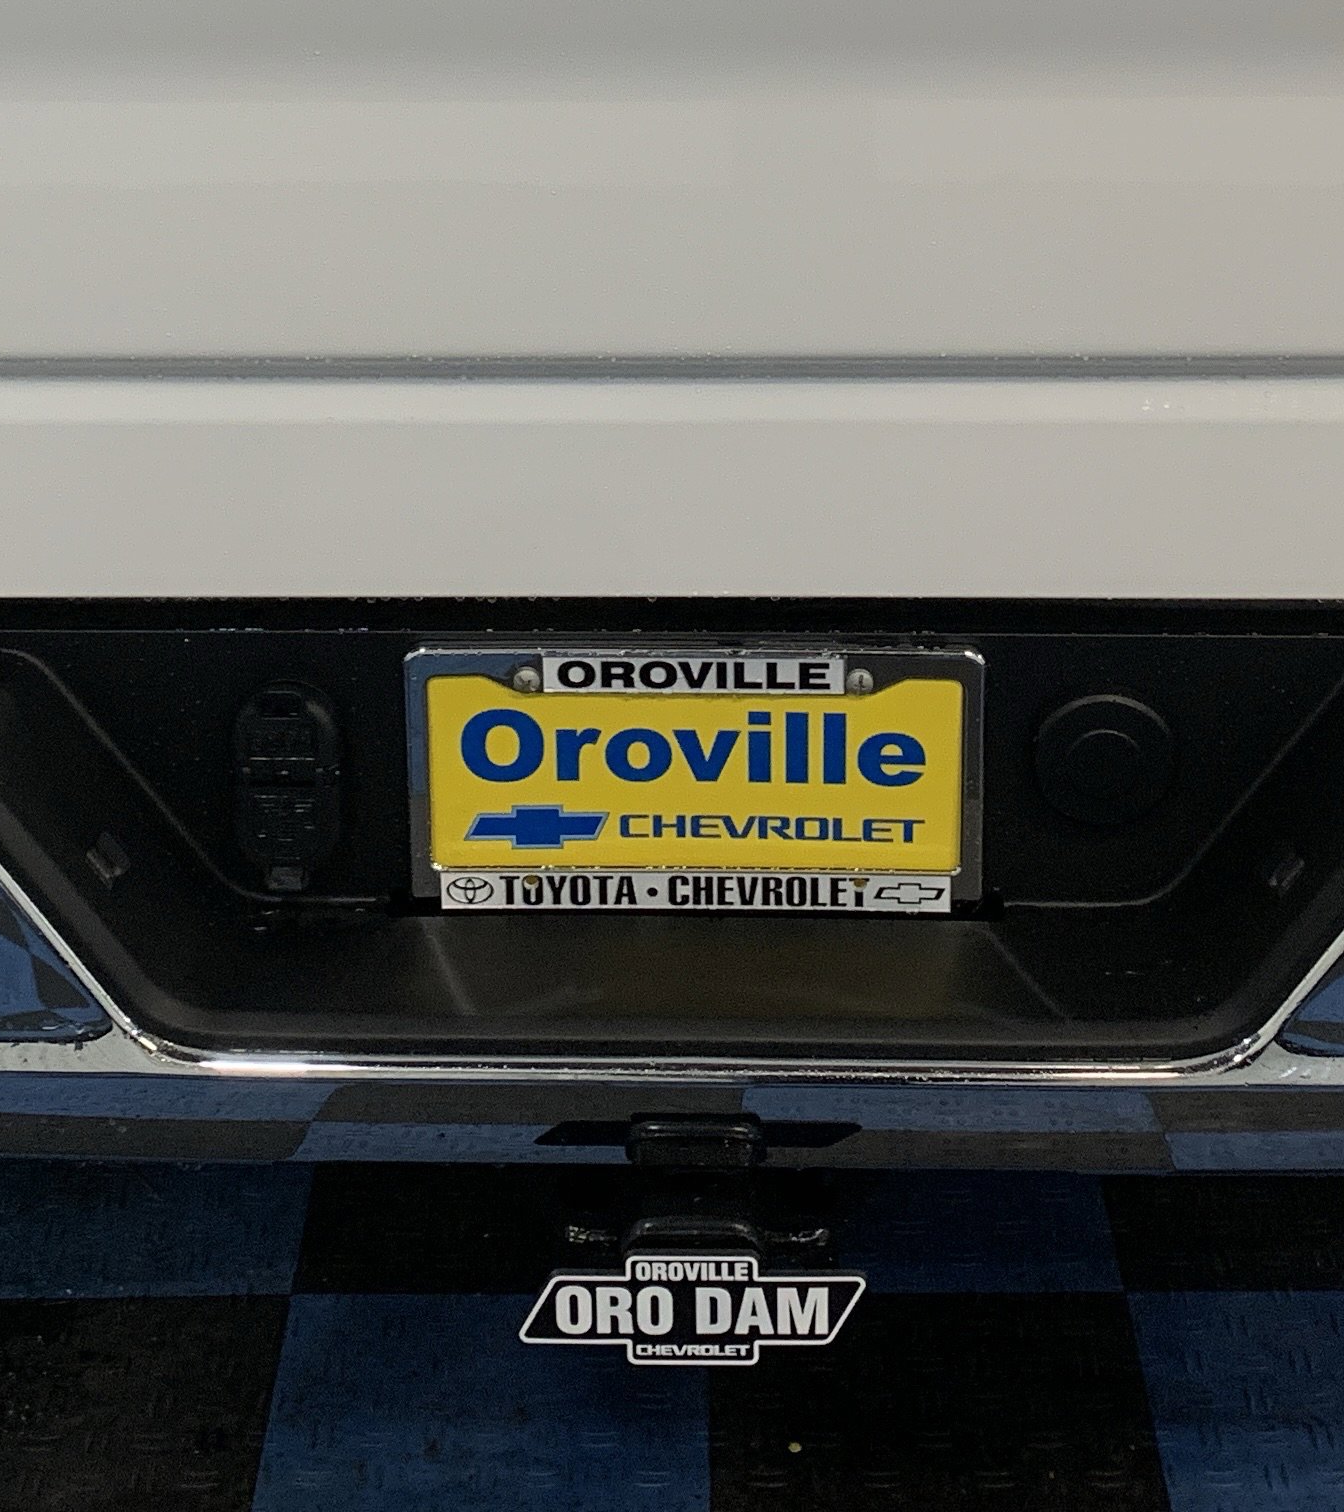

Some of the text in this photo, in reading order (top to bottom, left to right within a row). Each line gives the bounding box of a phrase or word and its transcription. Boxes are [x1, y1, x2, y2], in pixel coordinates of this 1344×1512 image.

[556, 660, 831, 690] OROVILLE
[460, 708, 926, 787] Oroville
[619, 814, 926, 844] CHEVROLET
[500, 874, 873, 908] TOYOTA CHEVROLET
[635, 1262, 749, 1282] OROVILLE
[556, 1286, 829, 1336] ORO DAM
[635, 1344, 750, 1358] CHEVROLET
